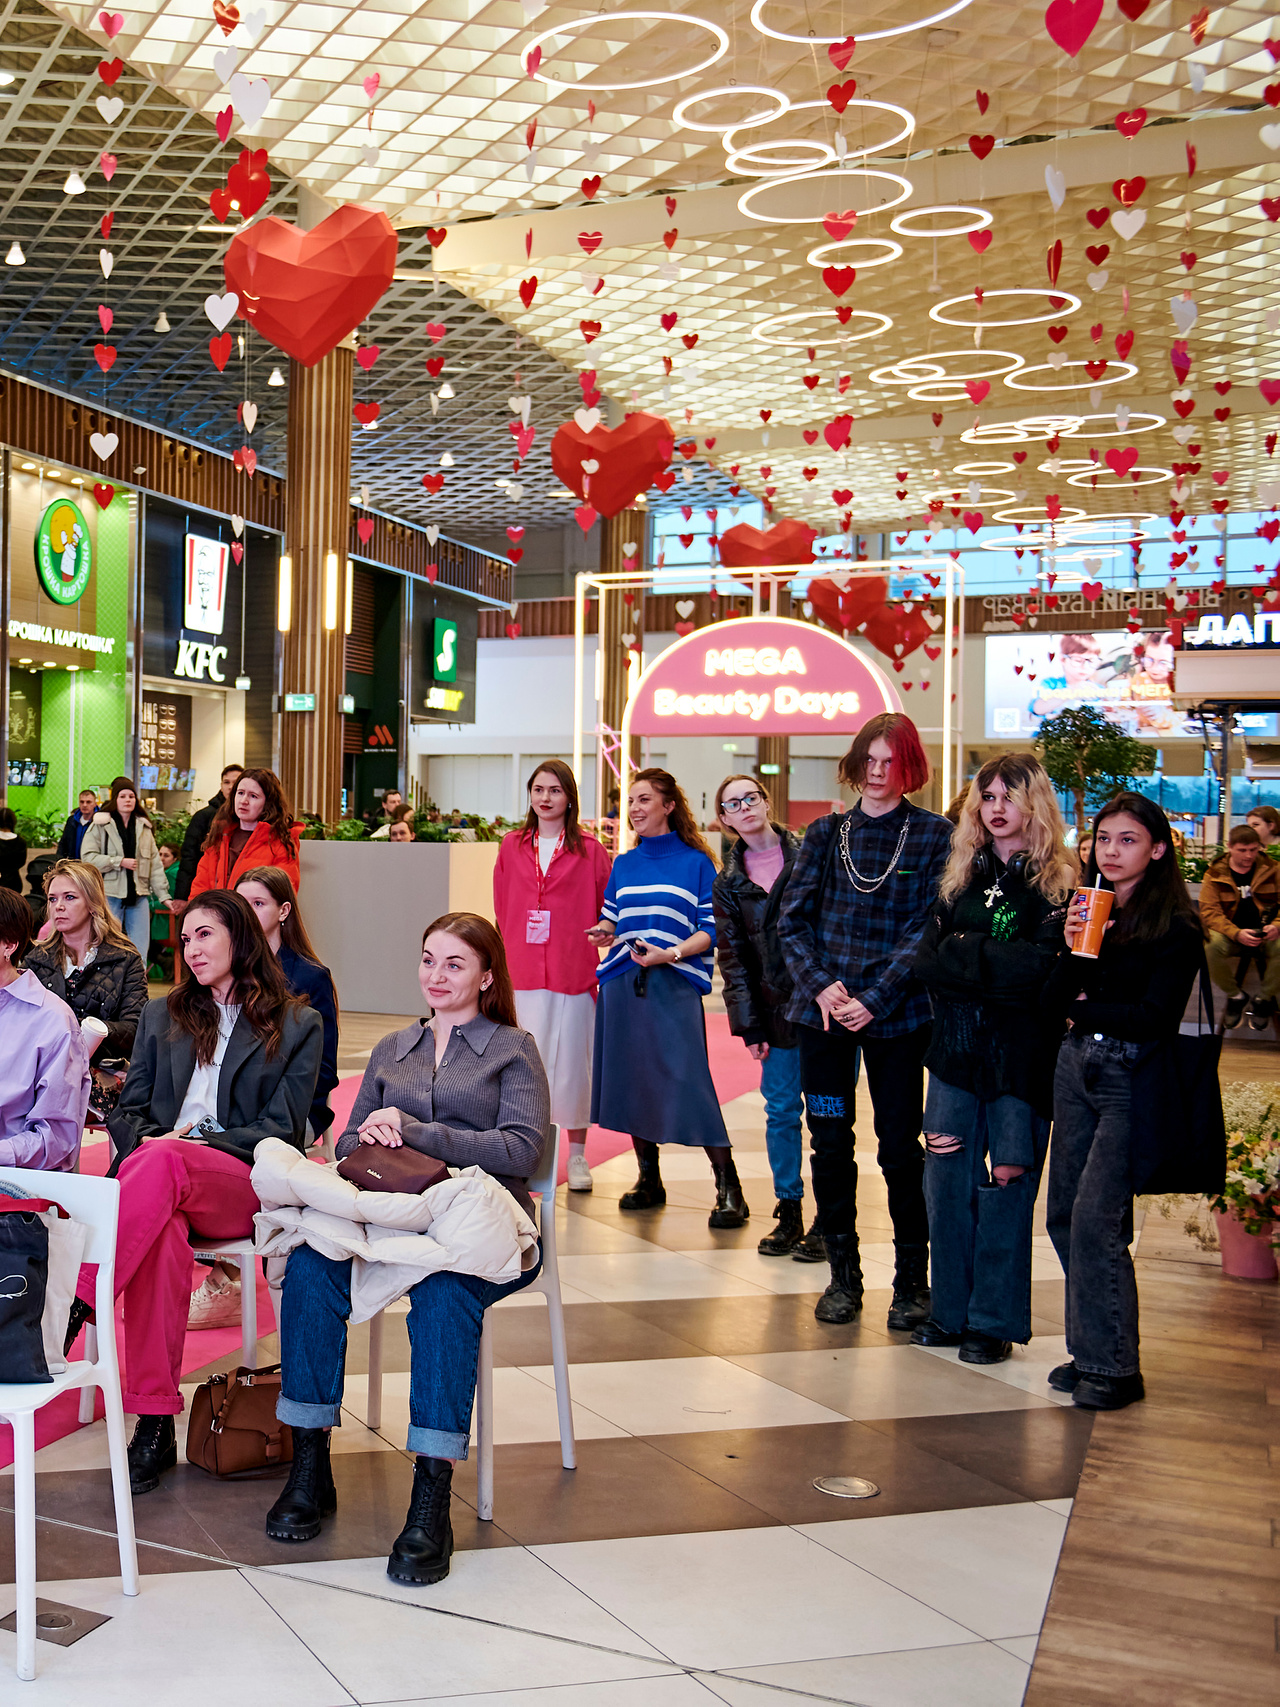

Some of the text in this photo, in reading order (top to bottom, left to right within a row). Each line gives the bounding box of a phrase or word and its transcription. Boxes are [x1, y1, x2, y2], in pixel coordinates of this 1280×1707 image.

[41, 534, 90, 598] КРОШКА КАРТОШКА
[174, 640, 228, 682] KFC
[704, 646, 808, 677] MEGA
[653, 686, 860, 721] Beauty Days
